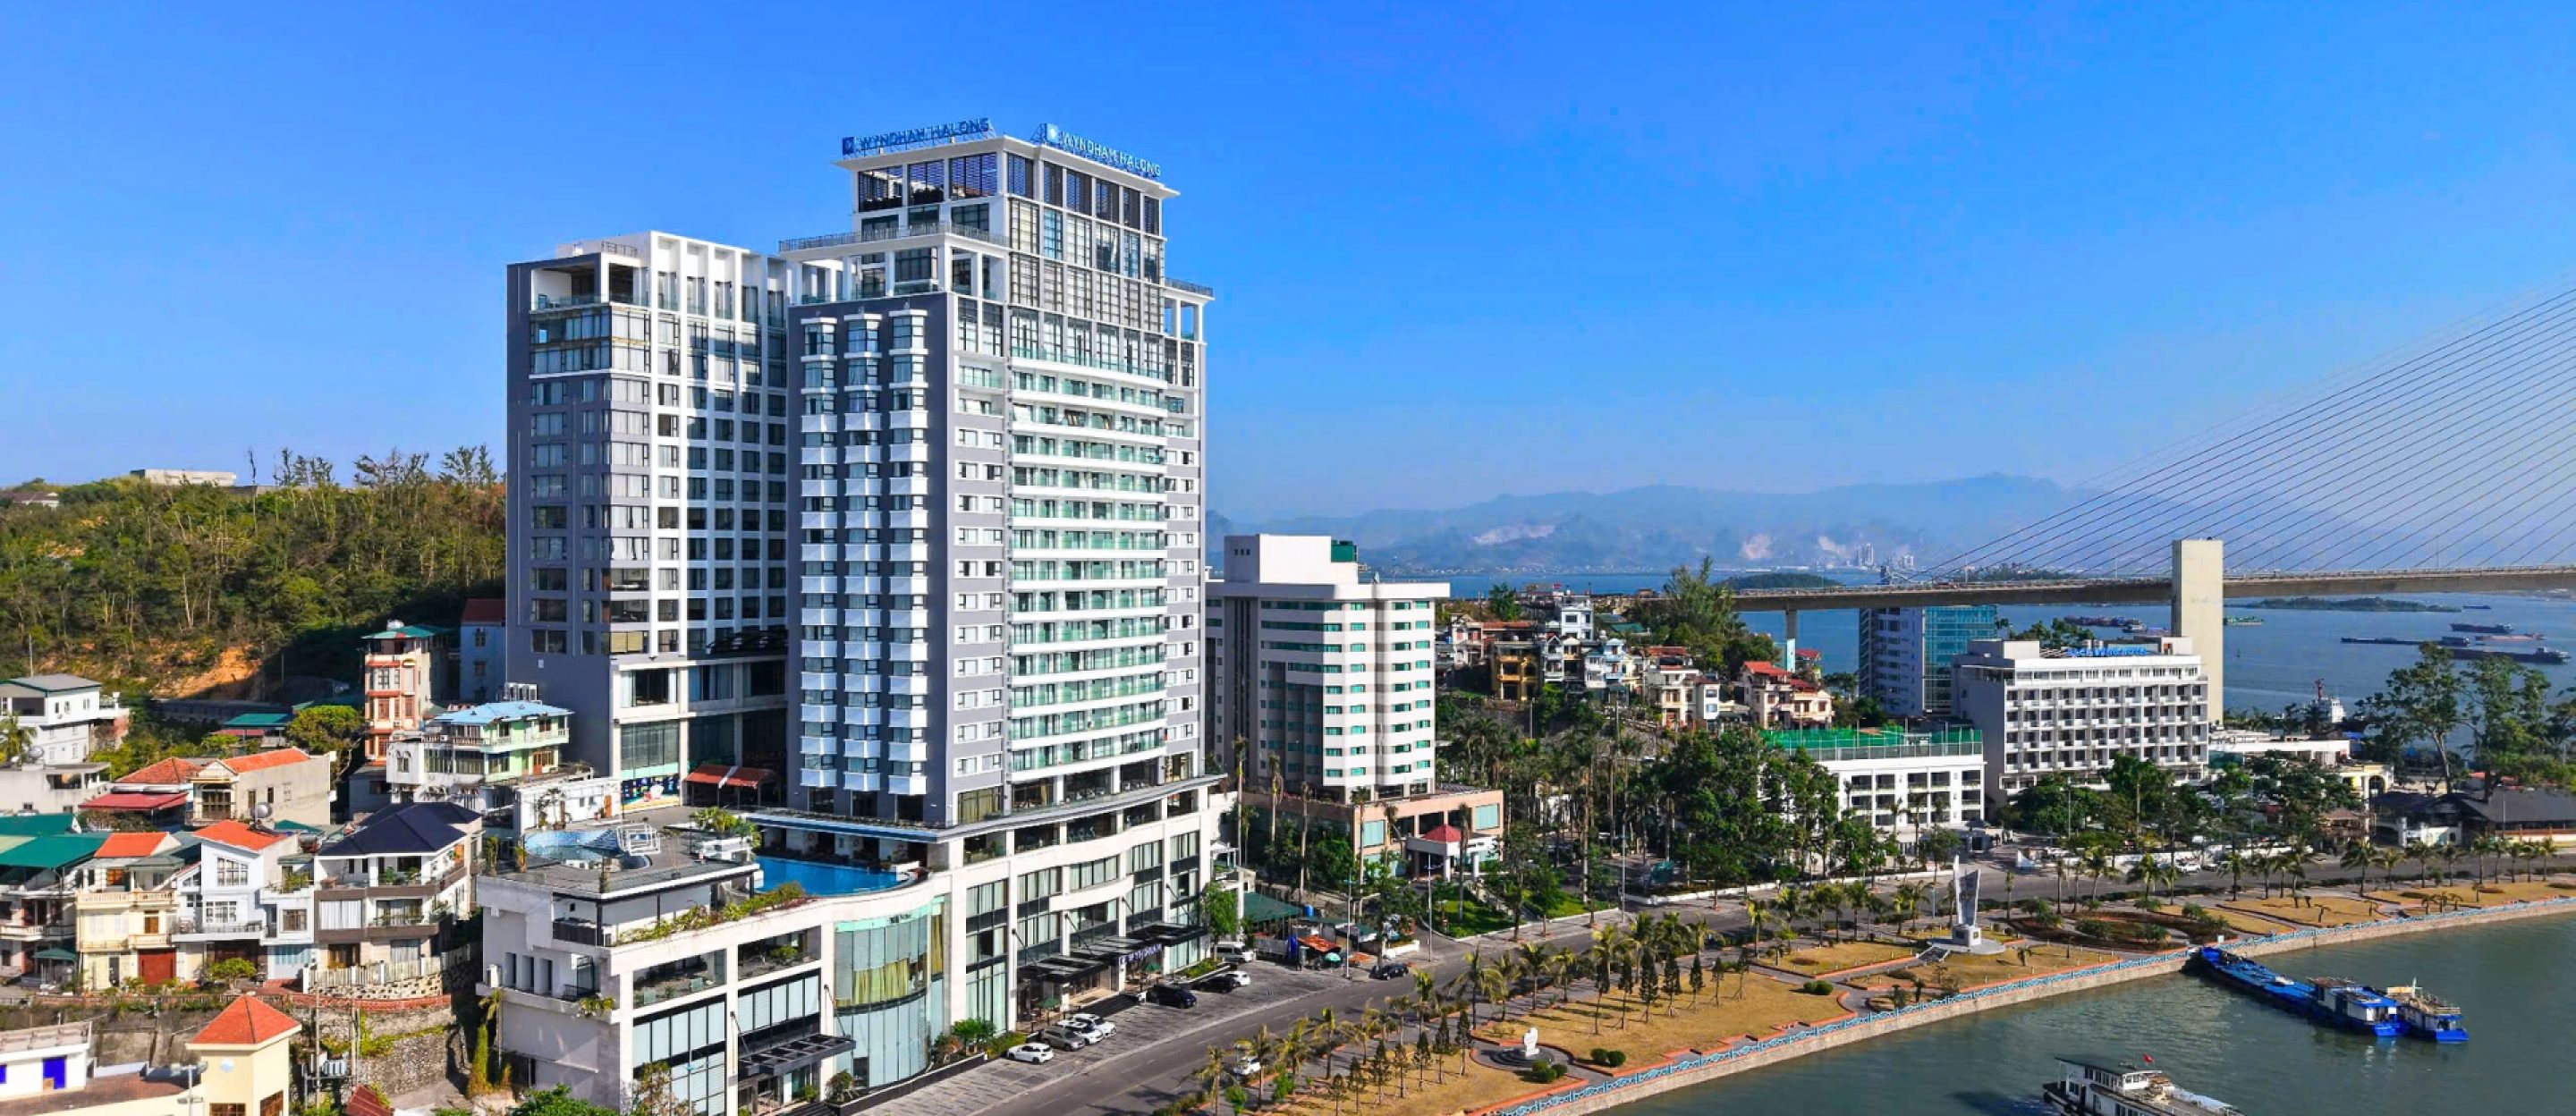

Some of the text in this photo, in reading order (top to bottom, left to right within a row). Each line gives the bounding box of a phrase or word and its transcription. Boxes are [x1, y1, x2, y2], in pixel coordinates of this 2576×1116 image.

[860, 117, 988, 149] WYNDHAM HALONG
[1062, 131, 1161, 176] WYNDHAM HALONG
